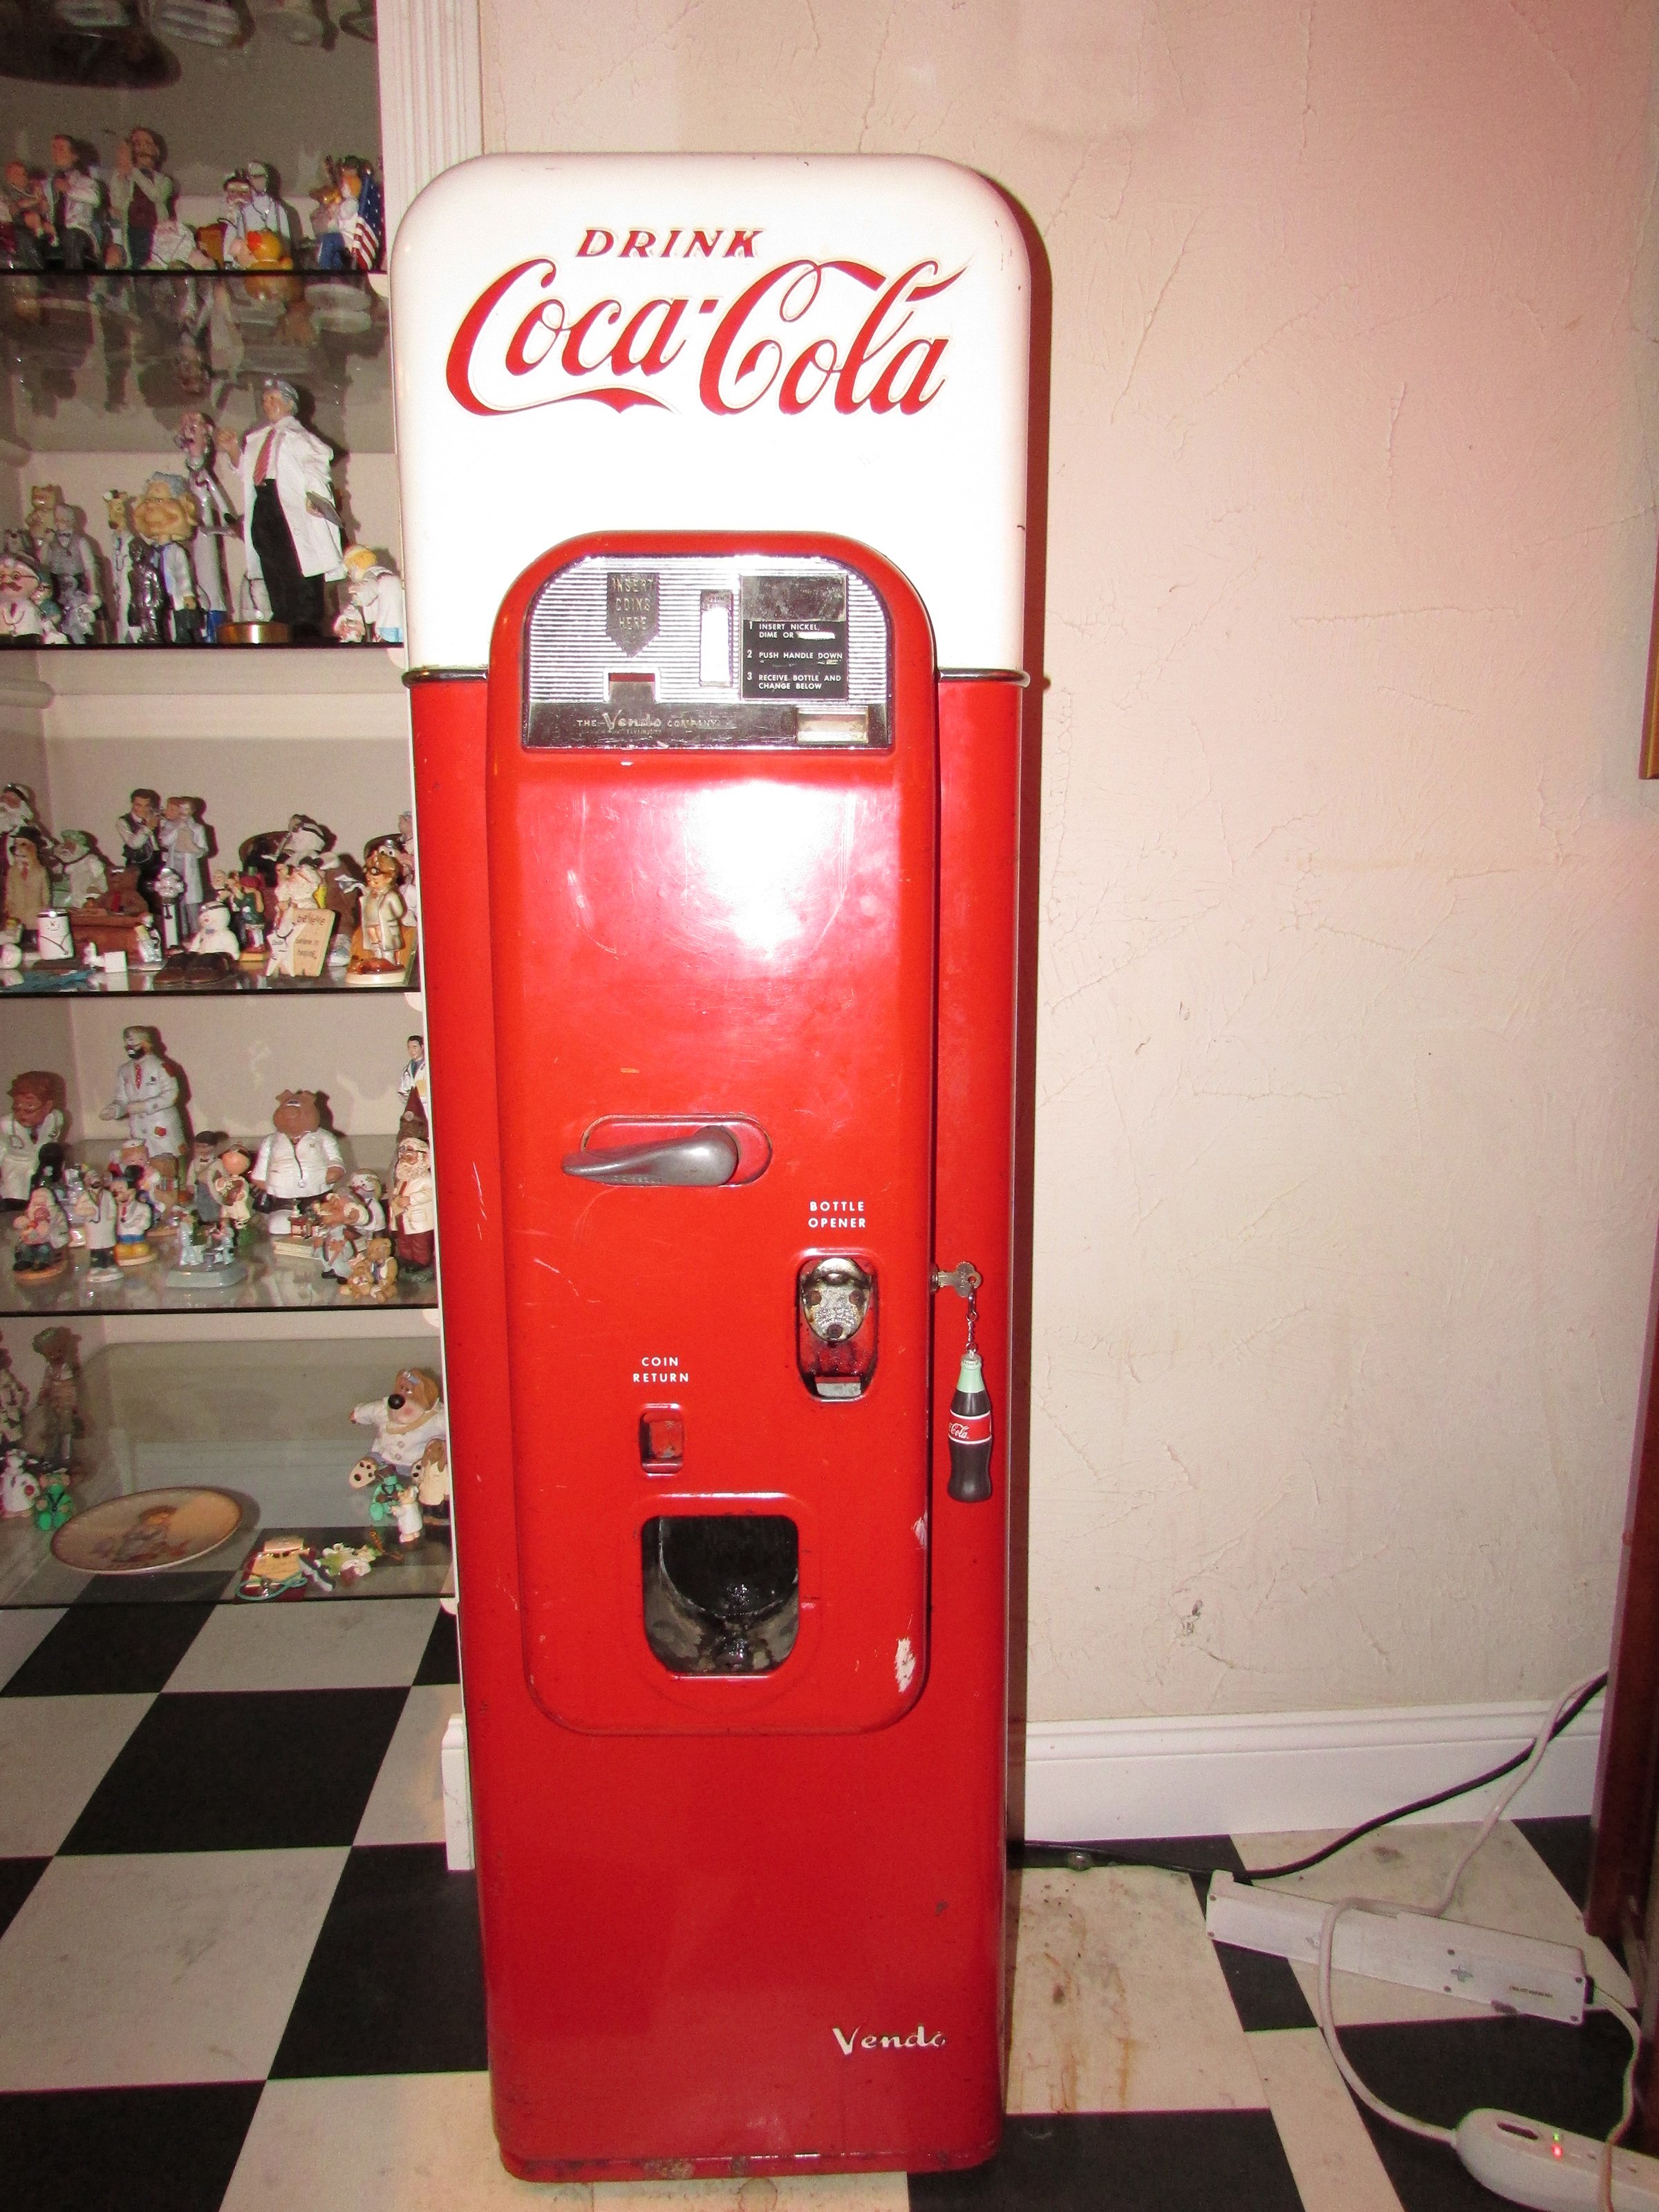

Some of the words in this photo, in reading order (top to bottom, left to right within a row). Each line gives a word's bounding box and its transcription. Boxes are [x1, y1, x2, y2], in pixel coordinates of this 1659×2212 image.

[575, 229, 764, 259] DRINK
[445, 258, 971, 416] Coca-Cola
[615, 597, 651, 612] COINS
[619, 616, 647, 630] HERE
[749, 621, 753, 630] 1
[747, 649, 753, 659] 2
[747, 672, 753, 681] 3
[601, 709, 662, 733] Vendo
[809, 1201, 865, 1212] BOTTLE
[807, 1217, 867, 1229] OPENER
[641, 1356, 679, 1367] COIN
[632, 1372, 689, 1383] RETURN
[832, 2025, 946, 2055] Vendo
